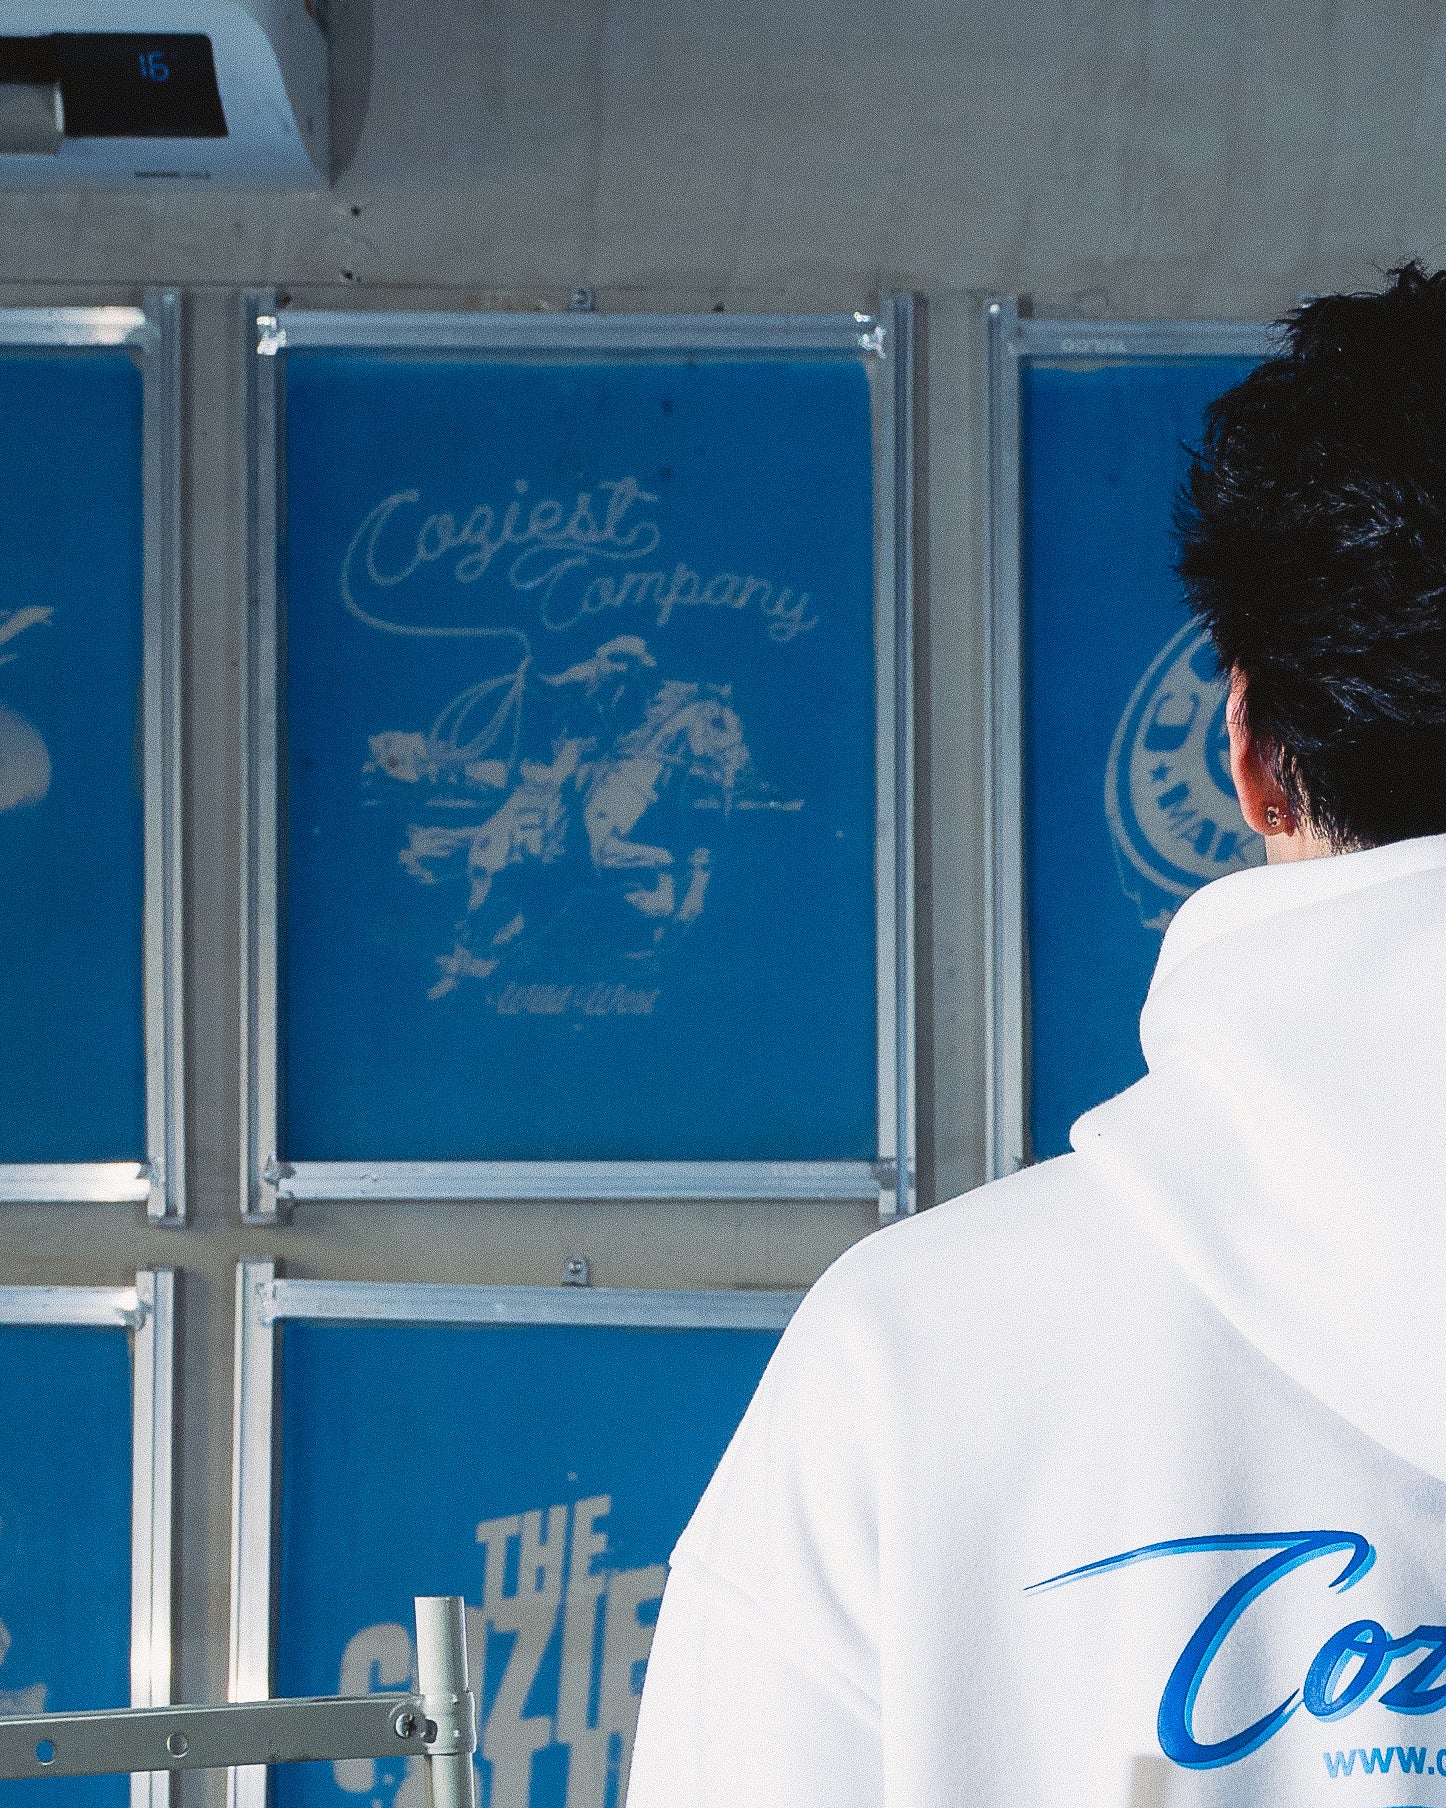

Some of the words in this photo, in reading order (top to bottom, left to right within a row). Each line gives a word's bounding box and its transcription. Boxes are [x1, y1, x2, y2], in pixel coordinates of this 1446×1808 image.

[138, 50, 170, 82] 16
[343, 476, 662, 585] Coziest
[512, 556, 819, 642] Company
[476, 1494, 612, 1606] THE
